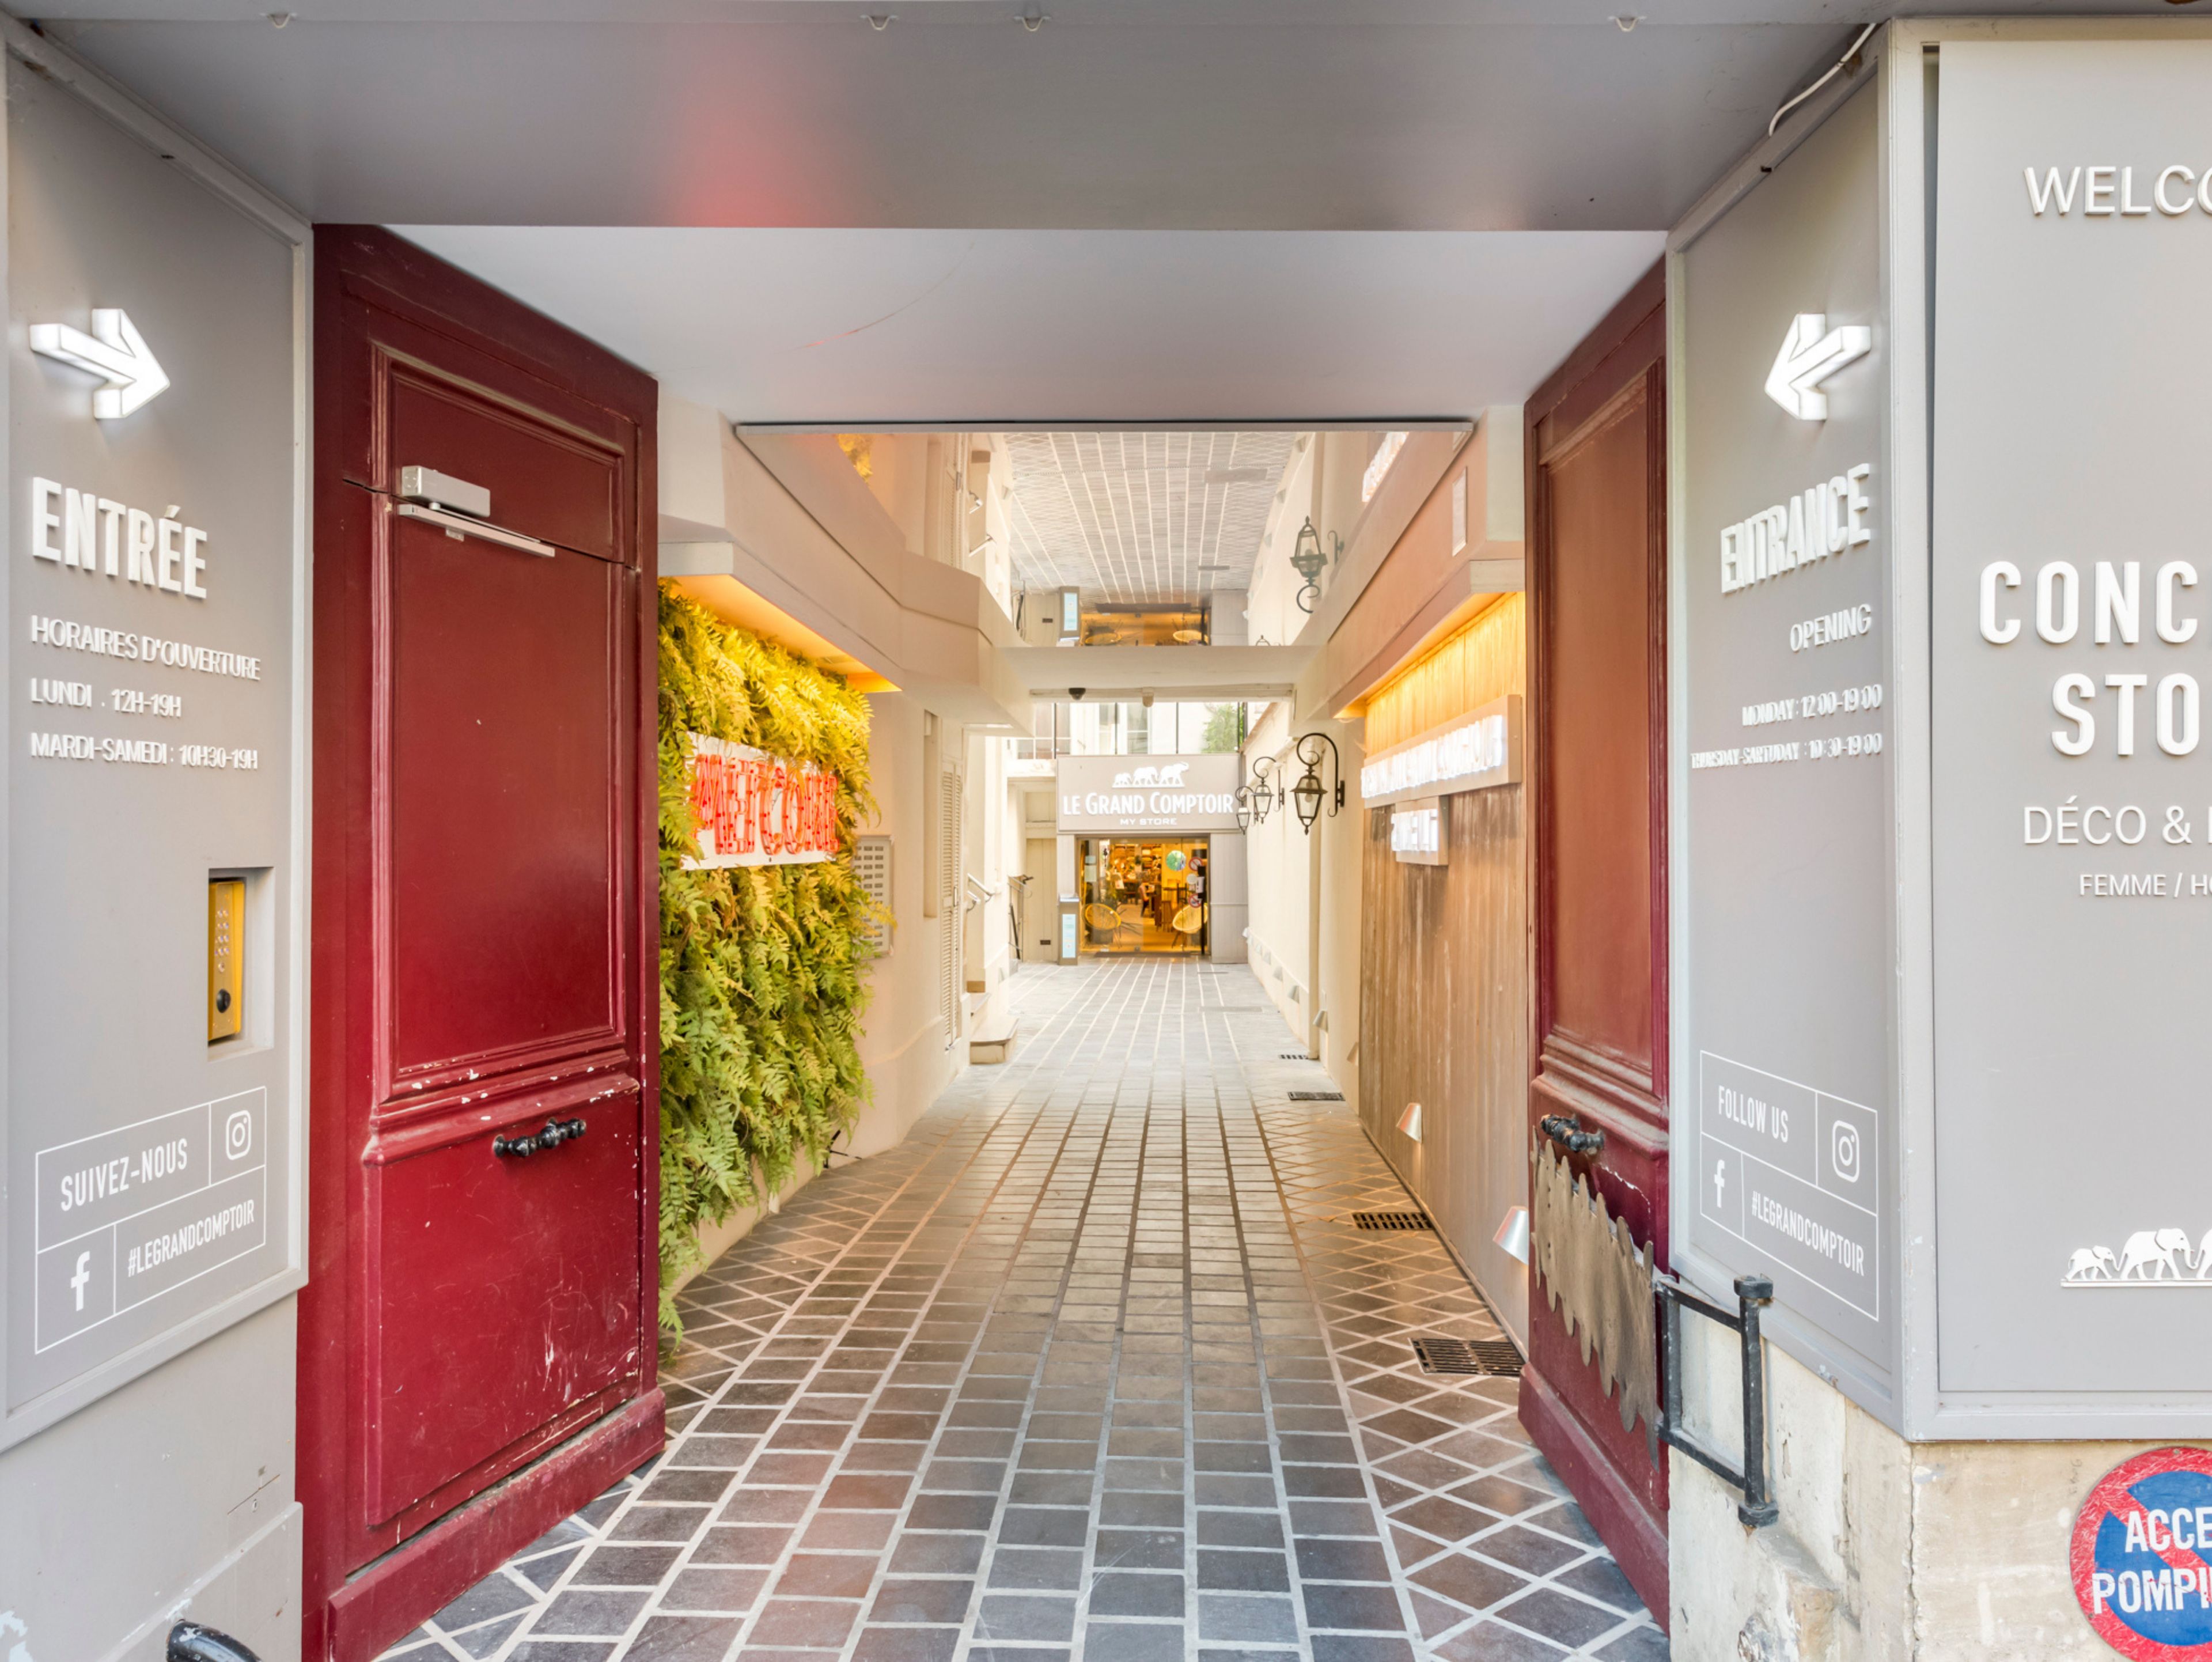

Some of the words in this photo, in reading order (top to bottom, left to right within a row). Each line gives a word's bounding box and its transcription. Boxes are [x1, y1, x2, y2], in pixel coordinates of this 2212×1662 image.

[32, 476, 207, 599] ENTRÉE
[1721, 463, 1870, 593] ENTRANCE
[31, 615, 138, 660] HORAIRES
[142, 636, 261, 681] D'OUVERTURE
[1790, 604, 1872, 652] OPENING
[31, 677, 92, 707] LUNDI
[111, 688, 182, 717] 12H-19H
[1742, 698, 1796, 727] MONDAY
[31, 732, 167, 765] MARDI-SAMEDI
[179, 744, 258, 770] 10H30-19H
[1063, 795, 1081, 815] LE
[1085, 792, 1145, 815] GRAND
[1150, 792, 1234, 814] COMPTOIR
[1139, 817, 1177, 826] STORE
[2024, 796, 2147, 845] DÉCO
[2162, 805, 2192, 845] &
[2080, 873, 2166, 896] FEMME
[2191, 874, 2212, 896] H
[1718, 1085, 1766, 1134] FOLLOW
[1772, 1106, 1789, 1143] US
[60, 1138, 188, 1212] SUIVEZ-NOUS
[127, 1198, 255, 1277] #LEGRANDCOMPTOIR
[1751, 1190, 1865, 1277] #LEGRANDCOMPTOIR
[2092, 1566, 2212, 1615] POMPI
